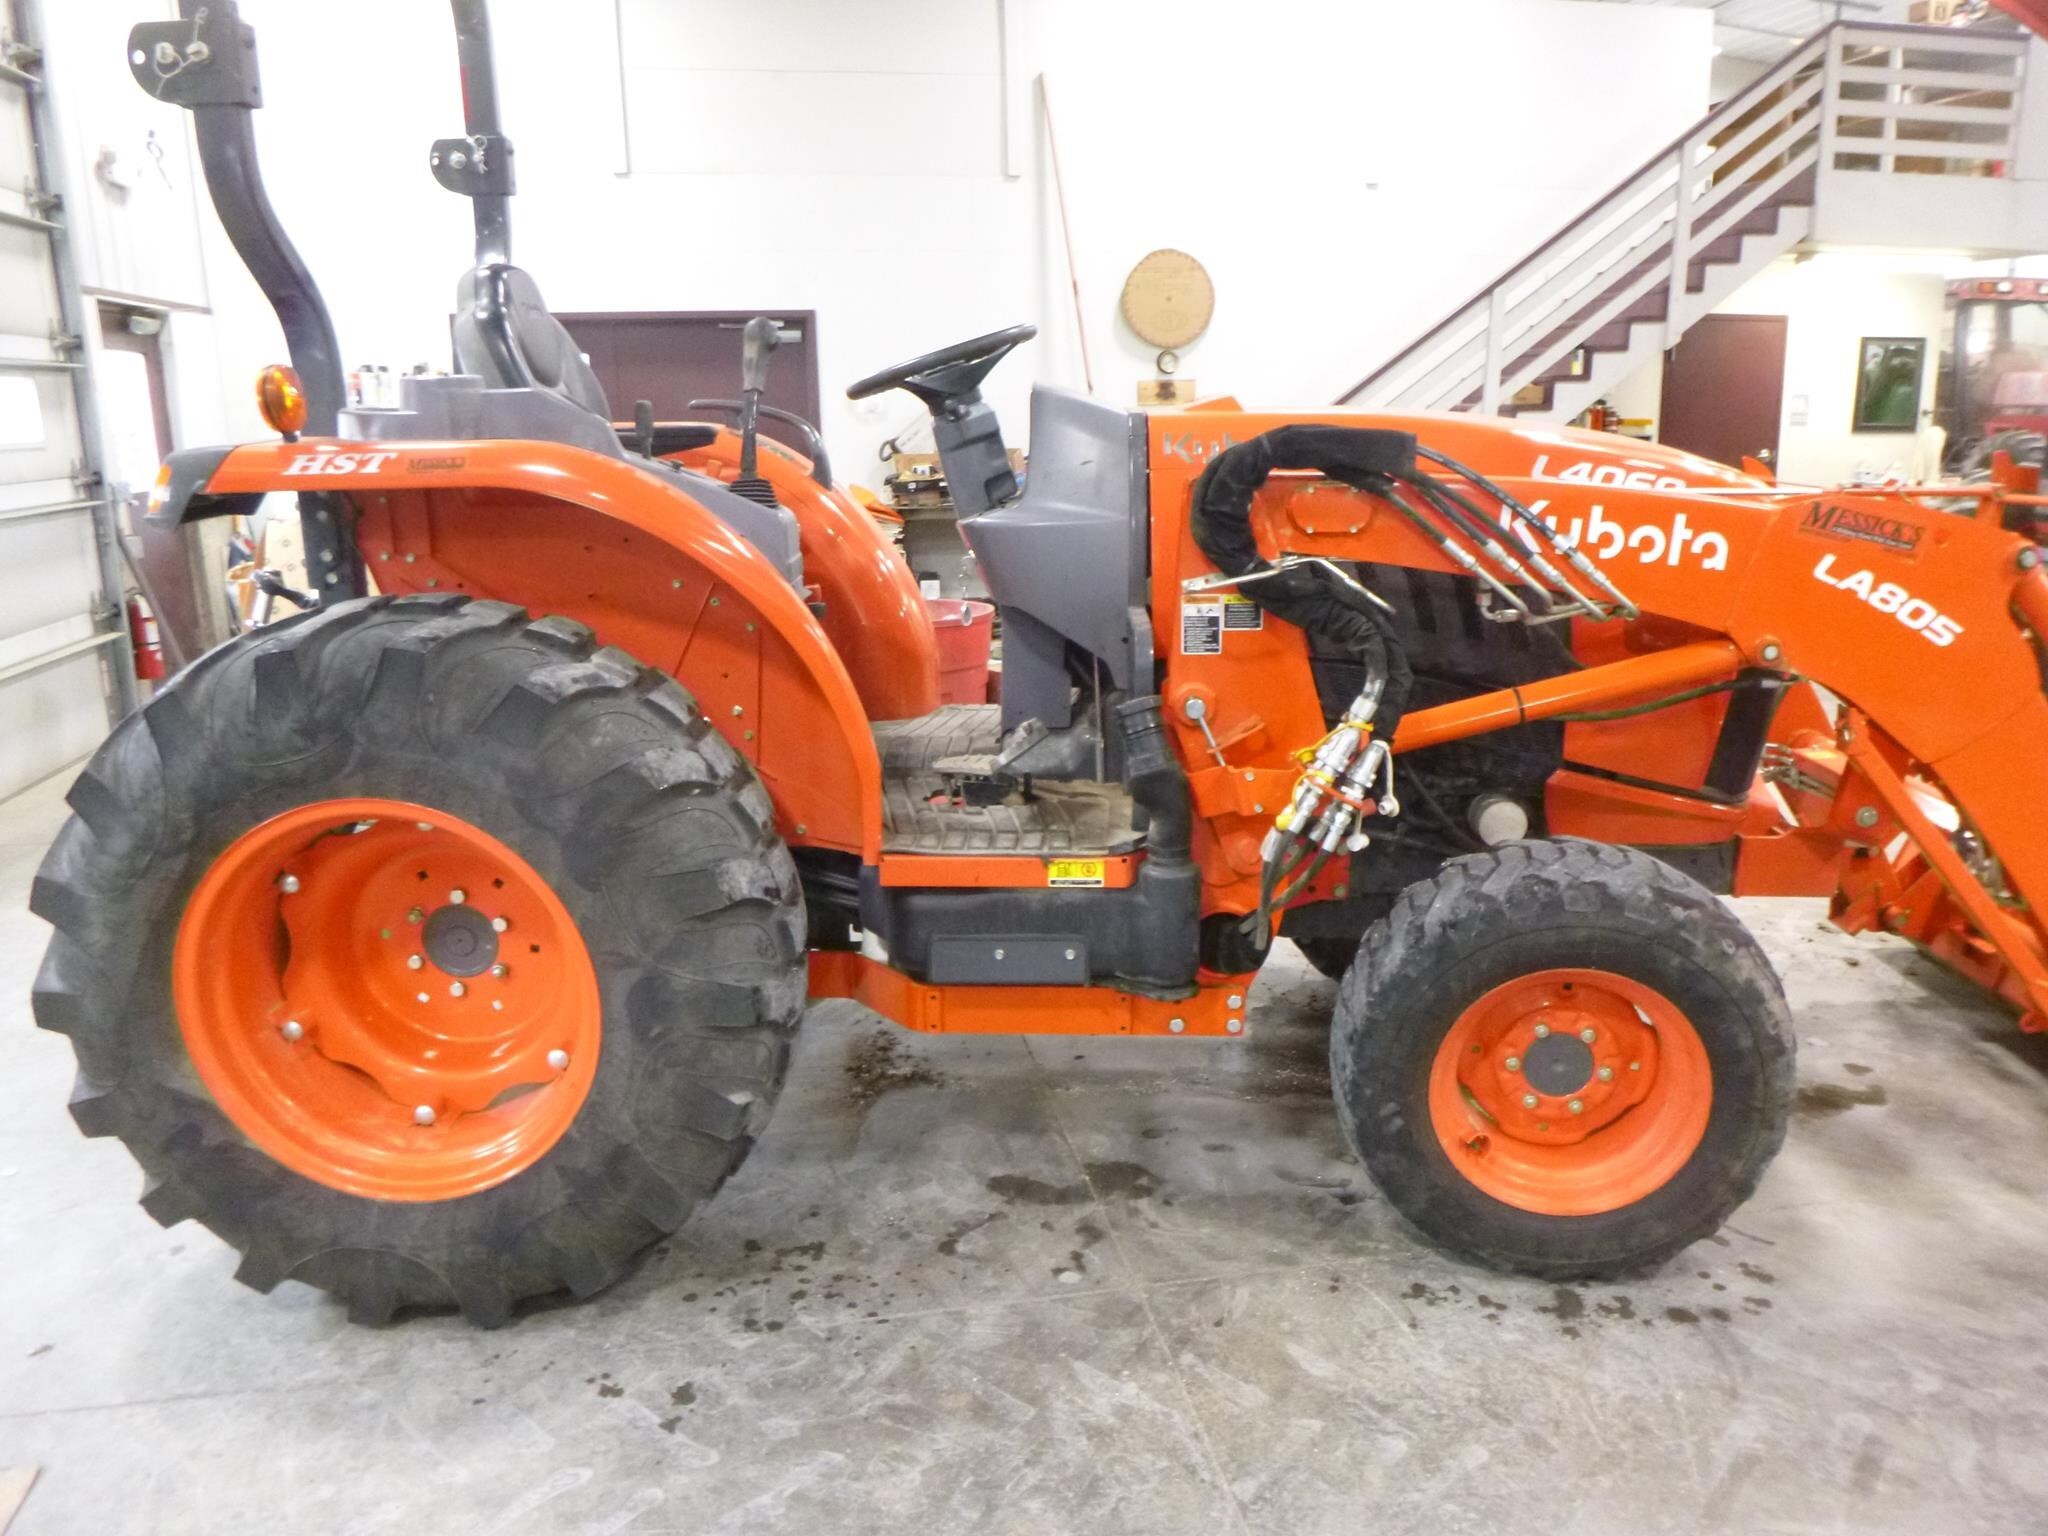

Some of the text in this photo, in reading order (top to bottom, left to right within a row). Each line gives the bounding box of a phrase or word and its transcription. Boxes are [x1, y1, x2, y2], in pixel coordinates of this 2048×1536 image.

[282, 452, 398, 476] HST
[1499, 500, 1729, 571] Kubota
[1813, 553, 1965, 647] LA805
